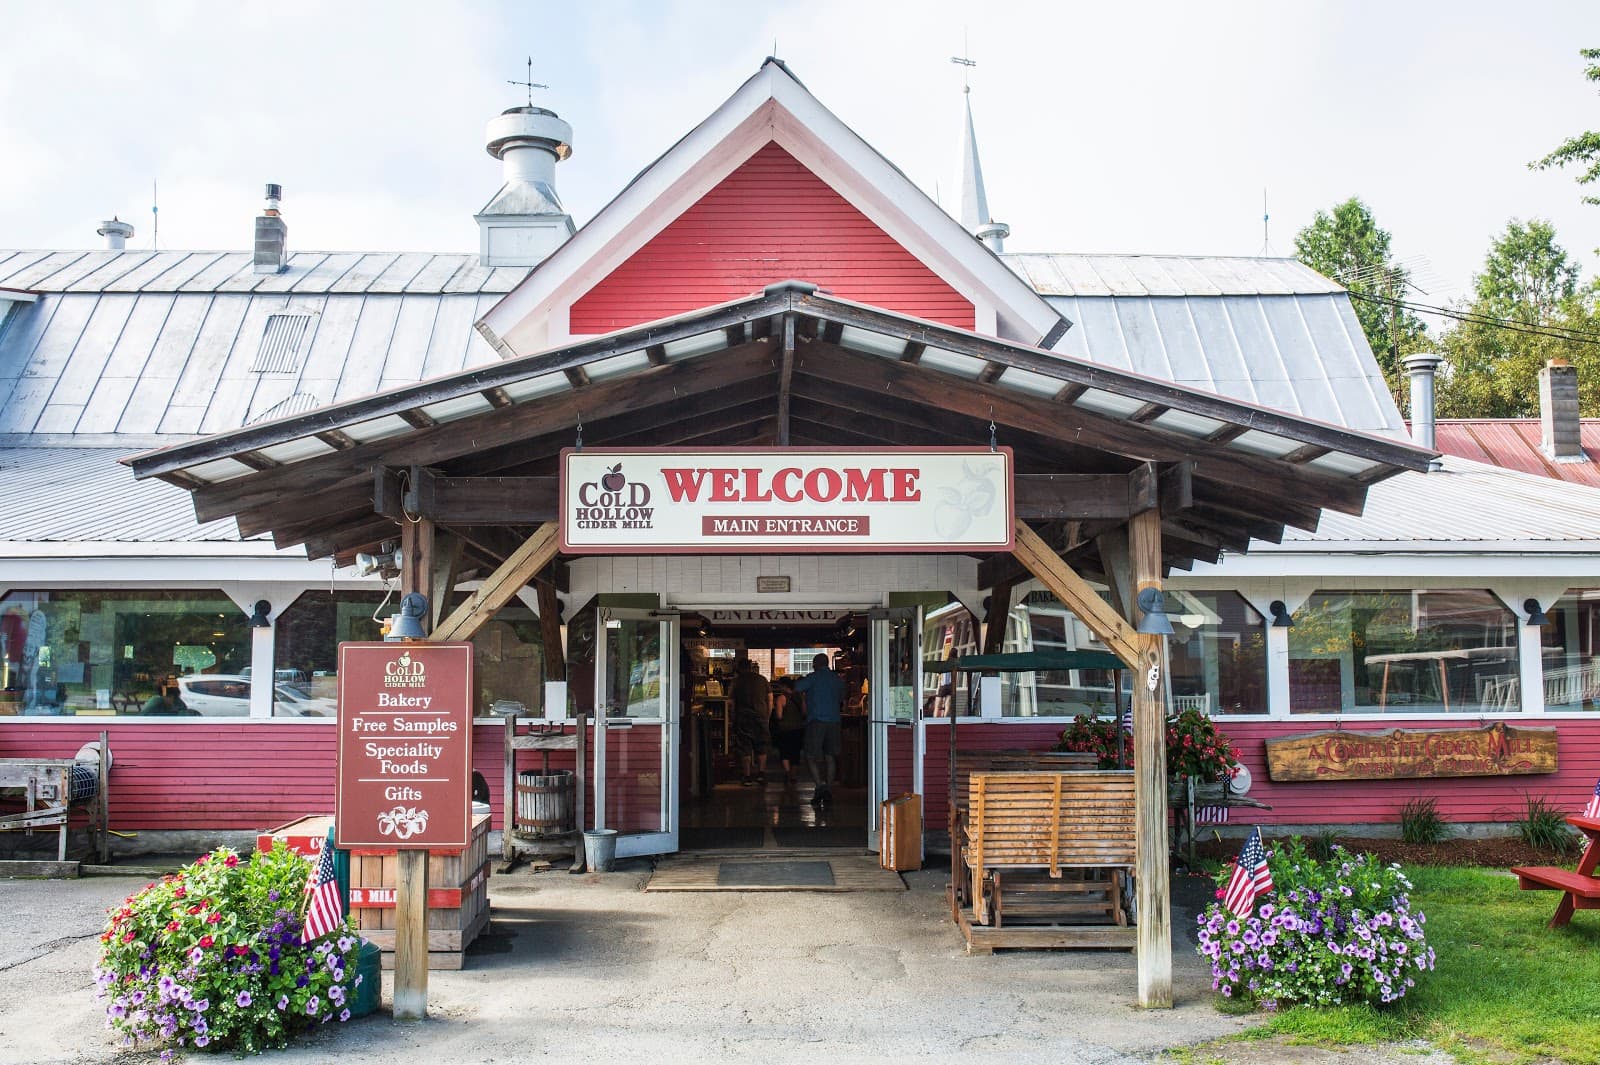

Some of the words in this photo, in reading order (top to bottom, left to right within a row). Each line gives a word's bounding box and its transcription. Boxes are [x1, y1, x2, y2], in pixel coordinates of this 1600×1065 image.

[660, 468, 921, 503] WELCOME
[579, 482, 651, 507] COLD
[576, 508, 654, 520] HOLLOW
[577, 521, 617, 529] CIDER
[622, 521, 654, 529] MILL
[713, 519, 760, 533] MAIN
[765, 519, 858, 533] ENTRANCE
[712, 610, 836, 620] ENTRANCE
[385, 661, 425, 676] COLD
[384, 675, 426, 683] HOLLOW
[378, 693, 432, 709] Bakery
[352, 718, 387, 732] Free
[394, 717, 458, 735] Samples
[365, 742, 443, 760] Speciality
[1308, 744, 1322, 760] A
[1424, 734, 1481, 760] CIDER
[380, 760, 428, 774] Foods
[384, 786, 422, 801] Gifts
